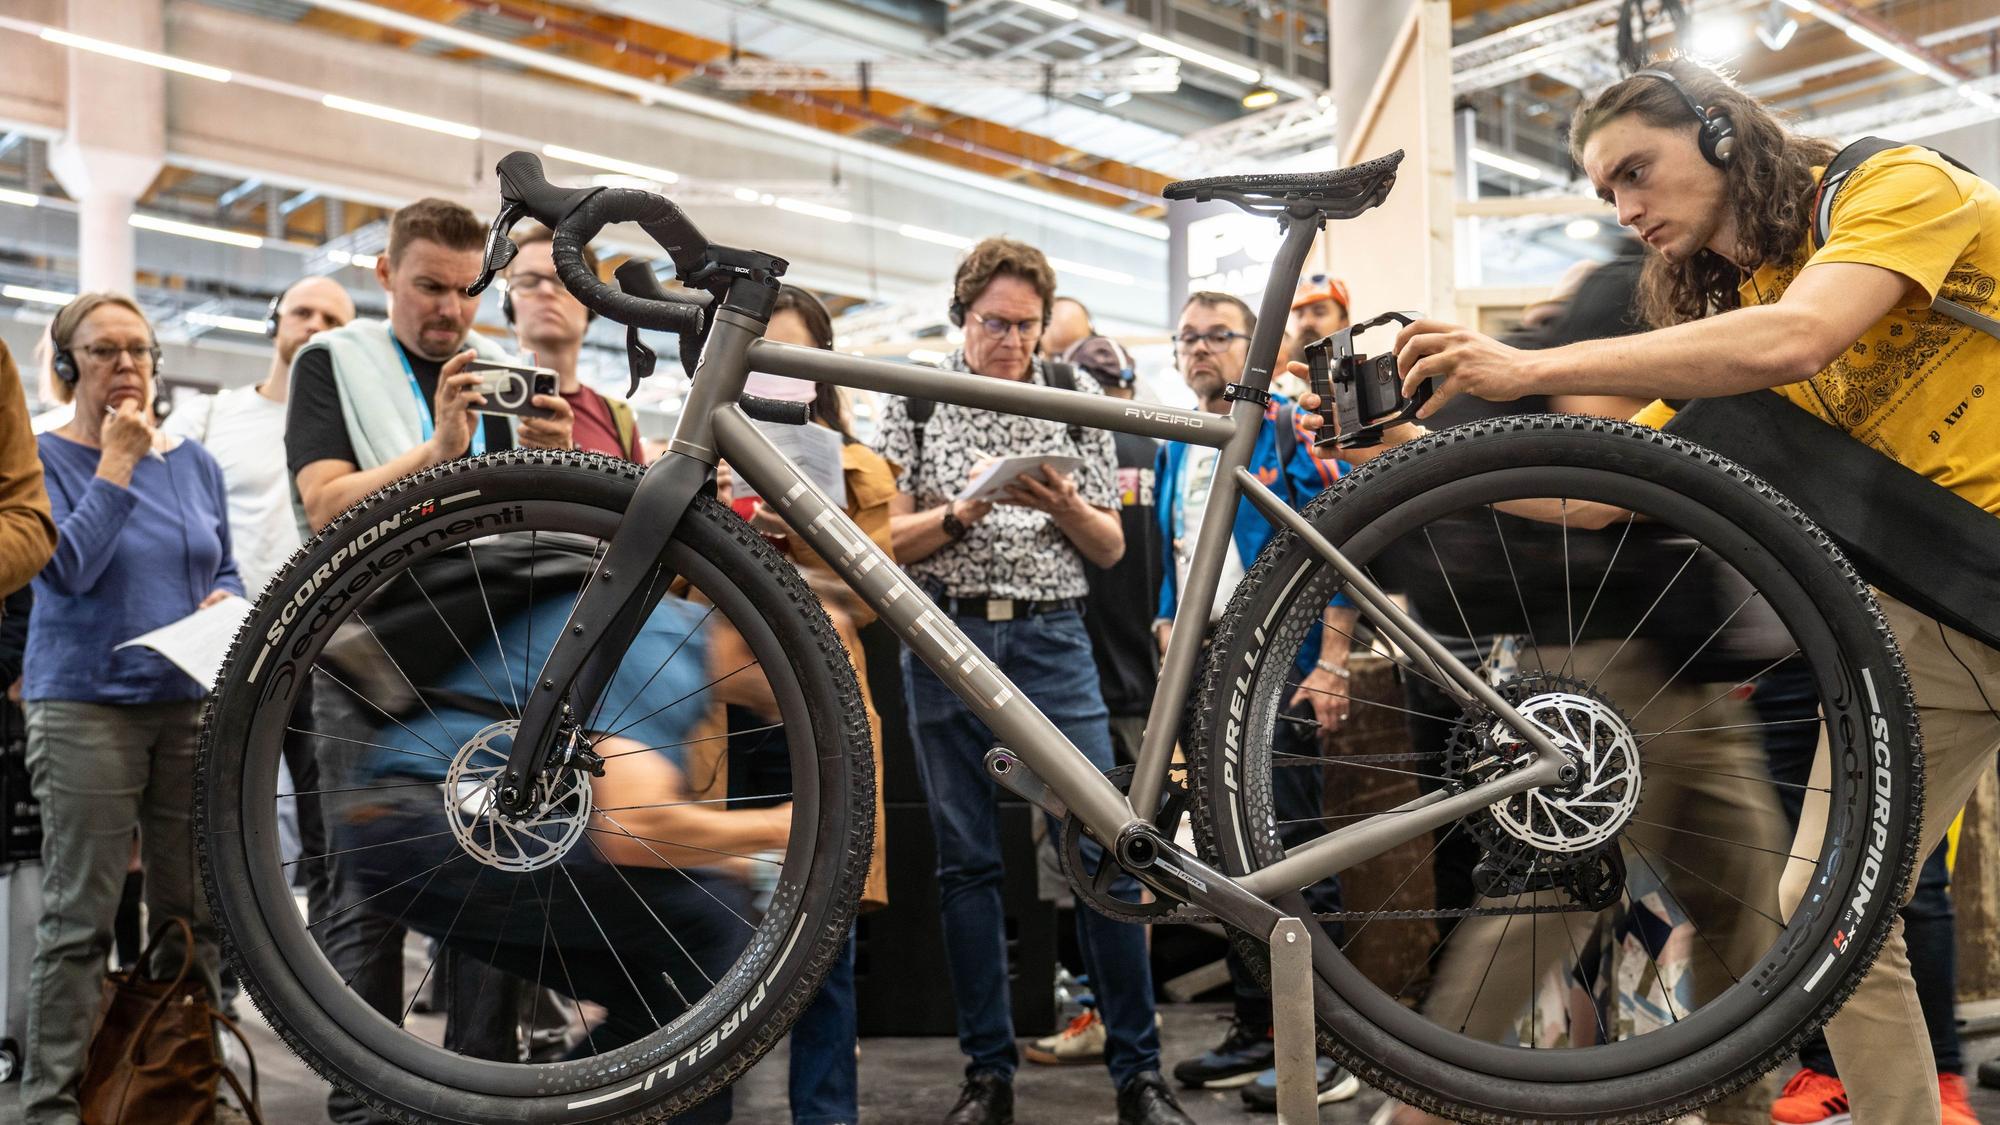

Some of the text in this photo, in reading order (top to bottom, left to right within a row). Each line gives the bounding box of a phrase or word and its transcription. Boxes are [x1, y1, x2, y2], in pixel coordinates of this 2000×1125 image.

[1124, 407, 1204, 429] AVEIRO
[421, 505, 435, 516] H
[267, 513, 401, 646] SCORPION
[1224, 626, 1266, 791] PIRELLI
[1852, 713, 1892, 918] SCORPION
[1832, 930, 1845, 950] H
[644, 981, 766, 1091] PIRELLI
